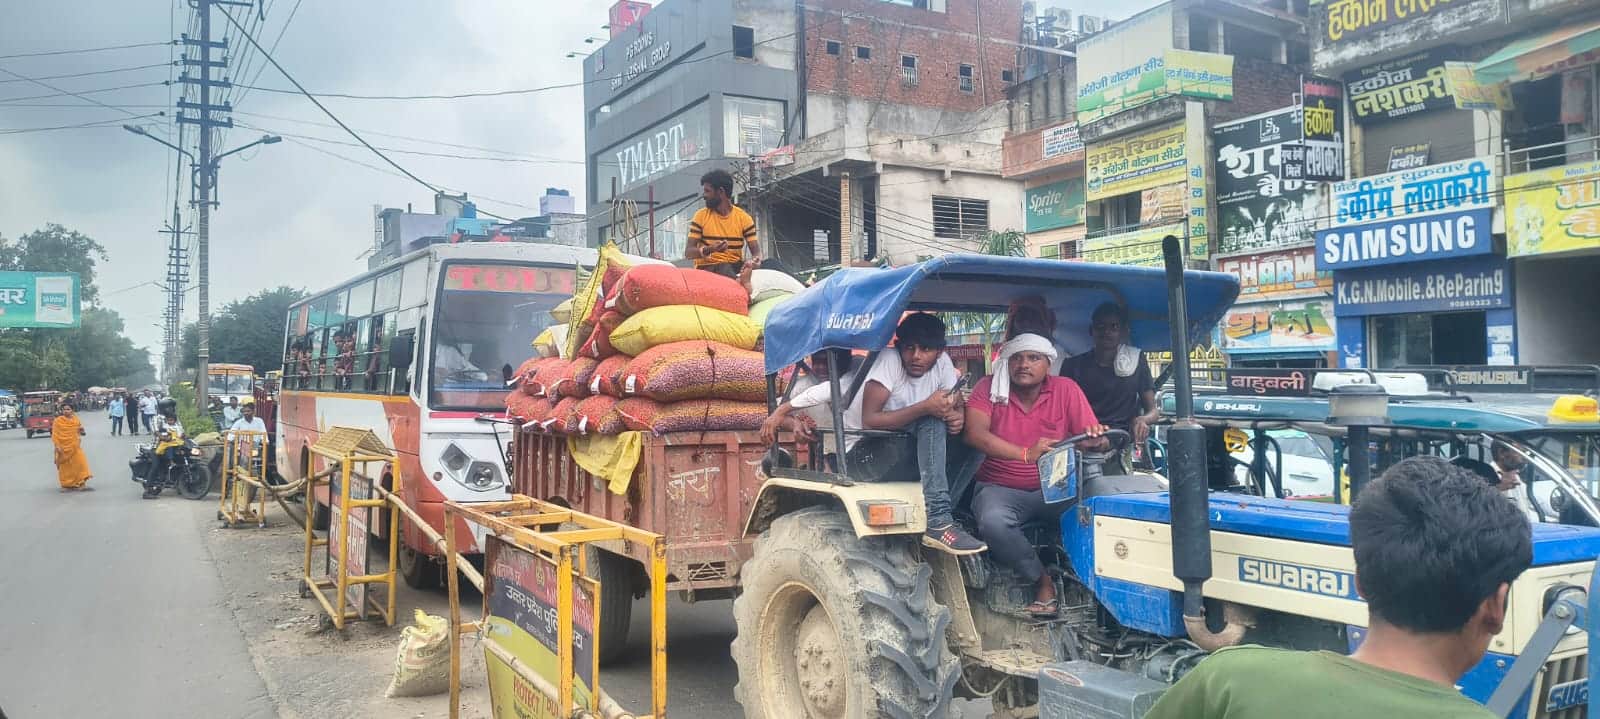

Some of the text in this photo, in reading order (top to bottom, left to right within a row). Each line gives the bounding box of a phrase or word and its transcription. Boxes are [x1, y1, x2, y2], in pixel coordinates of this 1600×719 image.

[1304, 99, 1335, 136] हकीम
[616, 123, 684, 192] VMART
[1029, 190, 1063, 213] Sprite
[1336, 180, 1394, 224] हकीम
[1323, 215, 1476, 264] SAMSUNG
[1231, 371, 1306, 393] बाहुबली
[543, 608, 559, 634] पुलि
